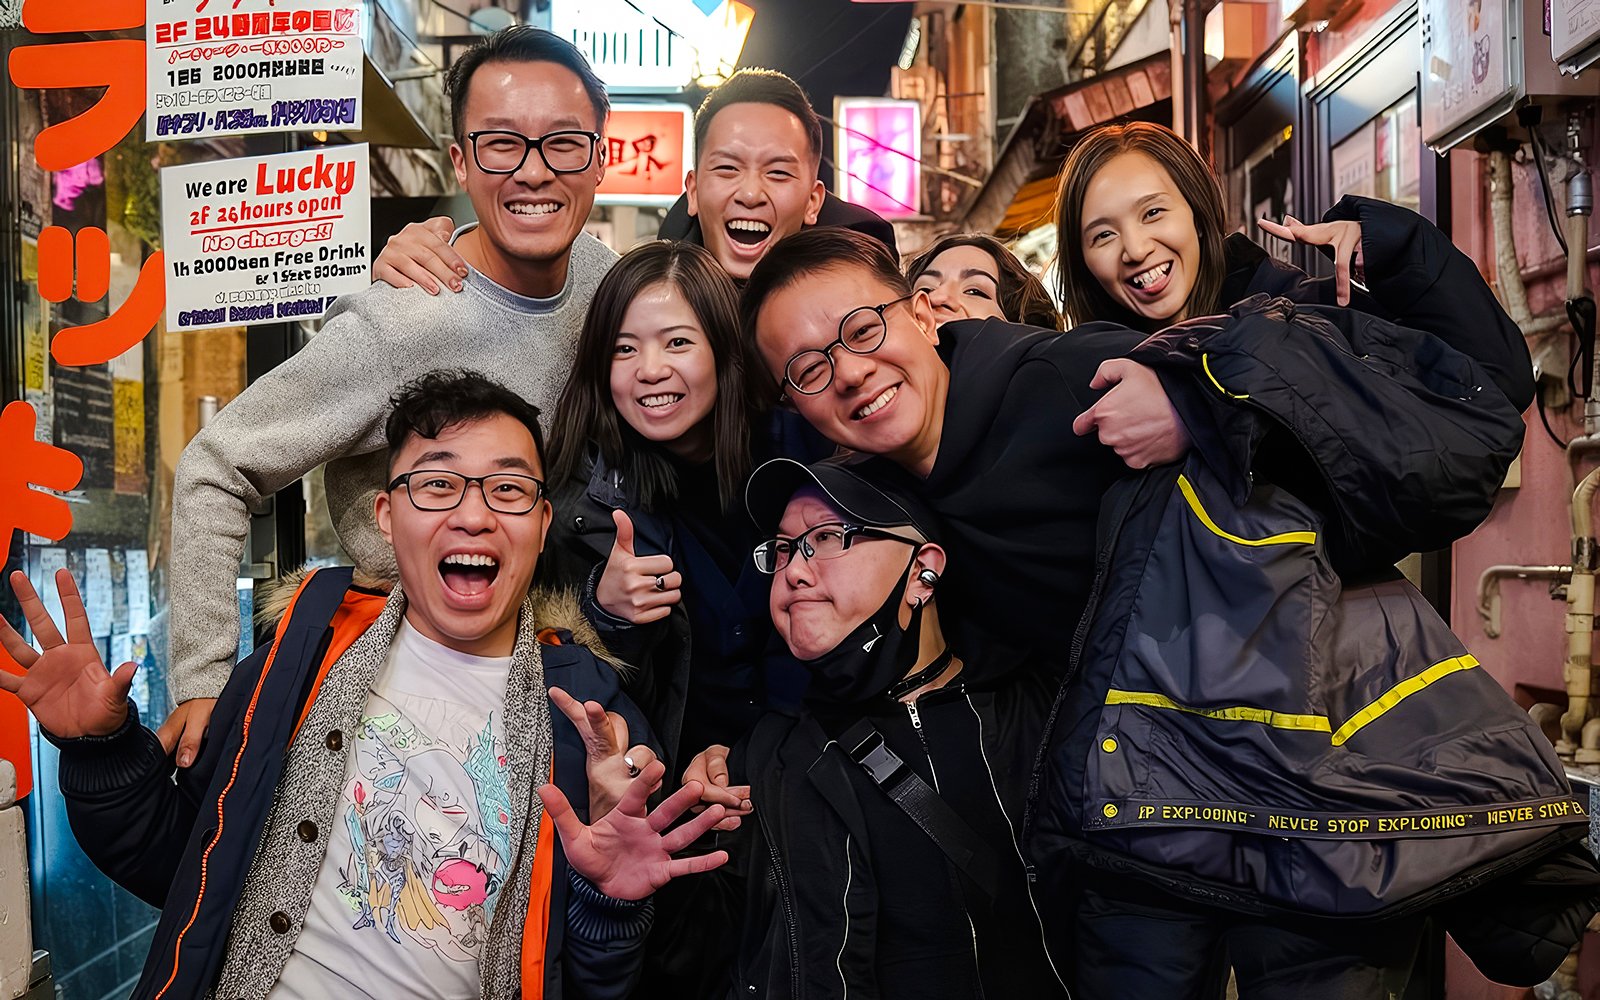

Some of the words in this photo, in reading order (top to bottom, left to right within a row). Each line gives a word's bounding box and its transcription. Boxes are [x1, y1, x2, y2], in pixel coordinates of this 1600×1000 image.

[185, 182, 212, 199] We
[216, 178, 248, 195] are
[256, 154, 356, 196] Lucky
[274, 250, 314, 267] Free
[318, 242, 366, 261] Drink
